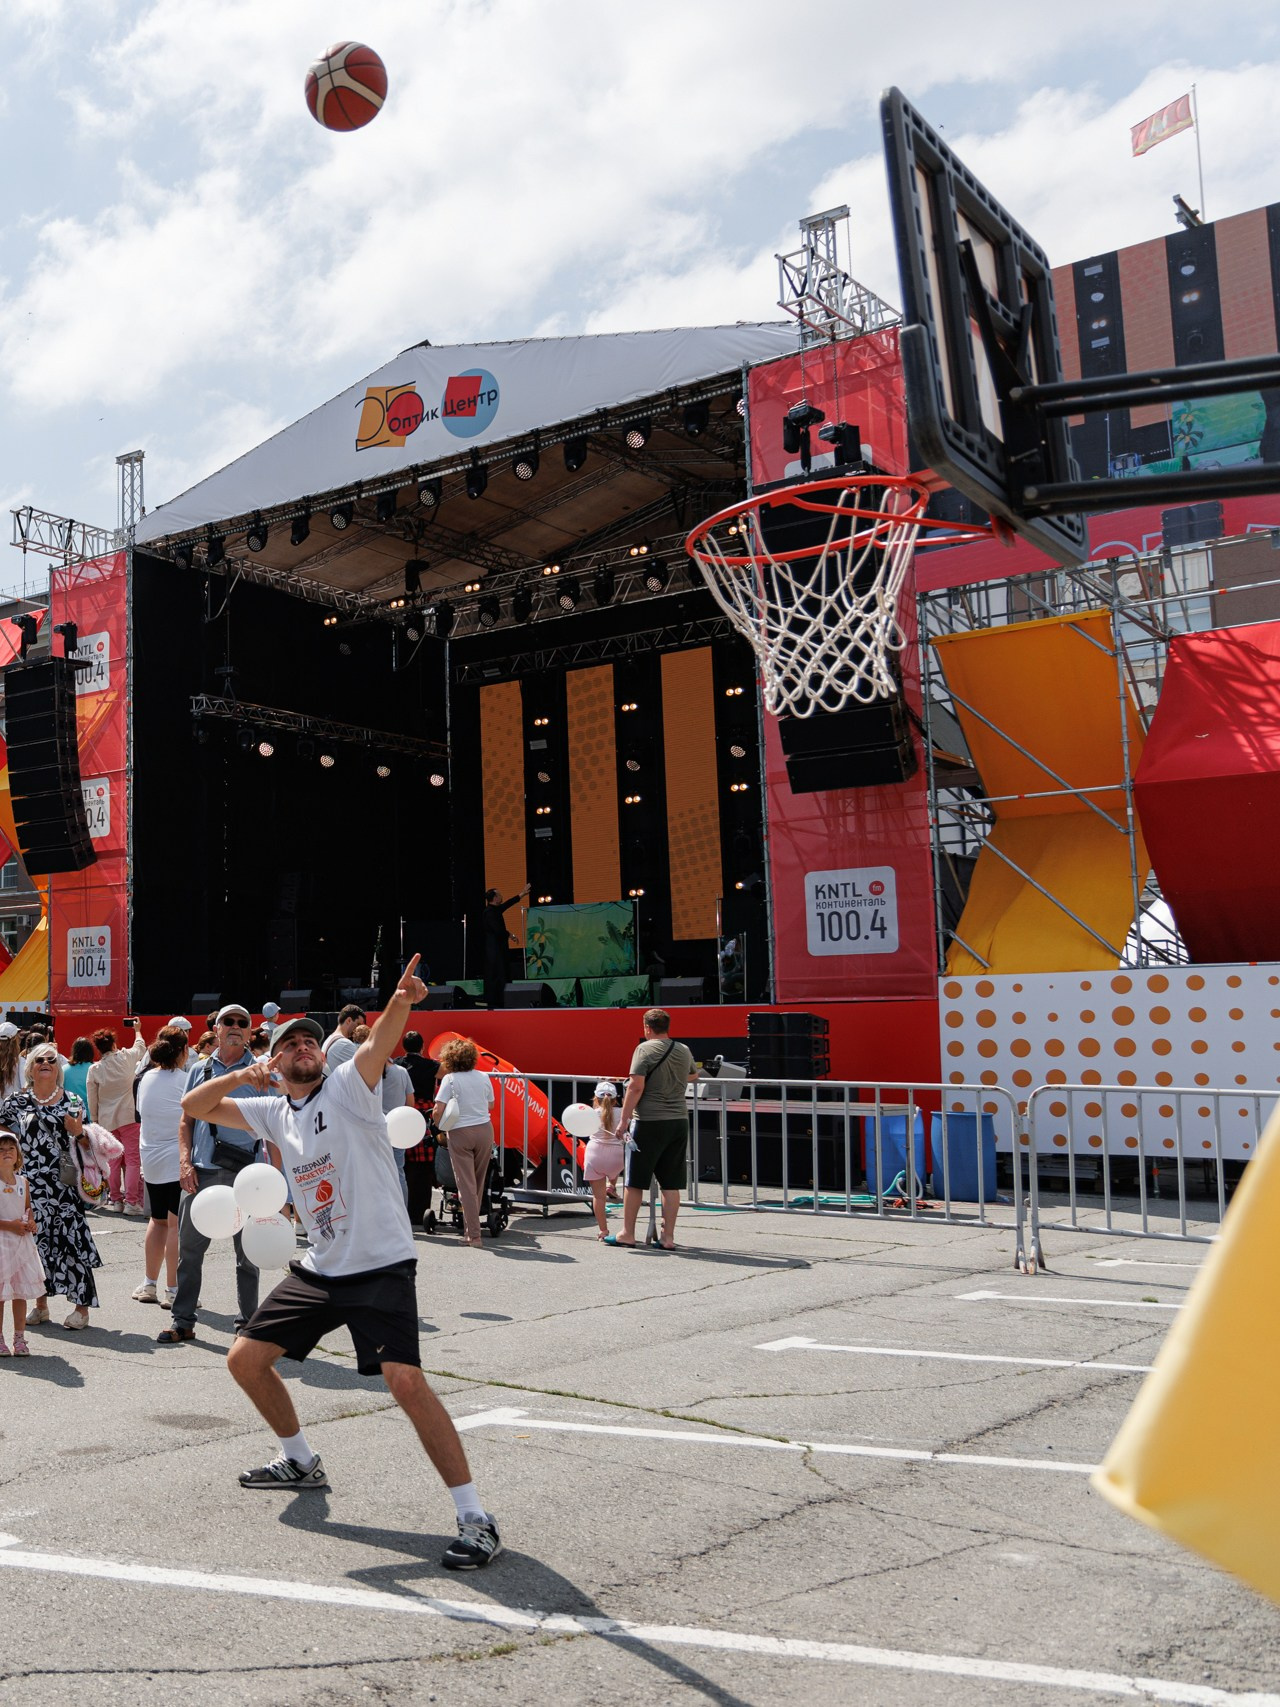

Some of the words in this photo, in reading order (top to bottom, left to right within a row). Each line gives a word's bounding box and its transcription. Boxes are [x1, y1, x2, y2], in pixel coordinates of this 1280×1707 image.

[389, 407, 439, 432] Оптик
[443, 389, 498, 416] Центр
[75, 661, 105, 686] 00.4
[85, 806, 105, 829] 0.4
[814, 882, 863, 900] KNTL
[815, 897, 887, 910] континенталь
[816, 908, 888, 942] 100.4
[72, 936, 95, 948] KNTL
[72, 955, 106, 977] 100.4
